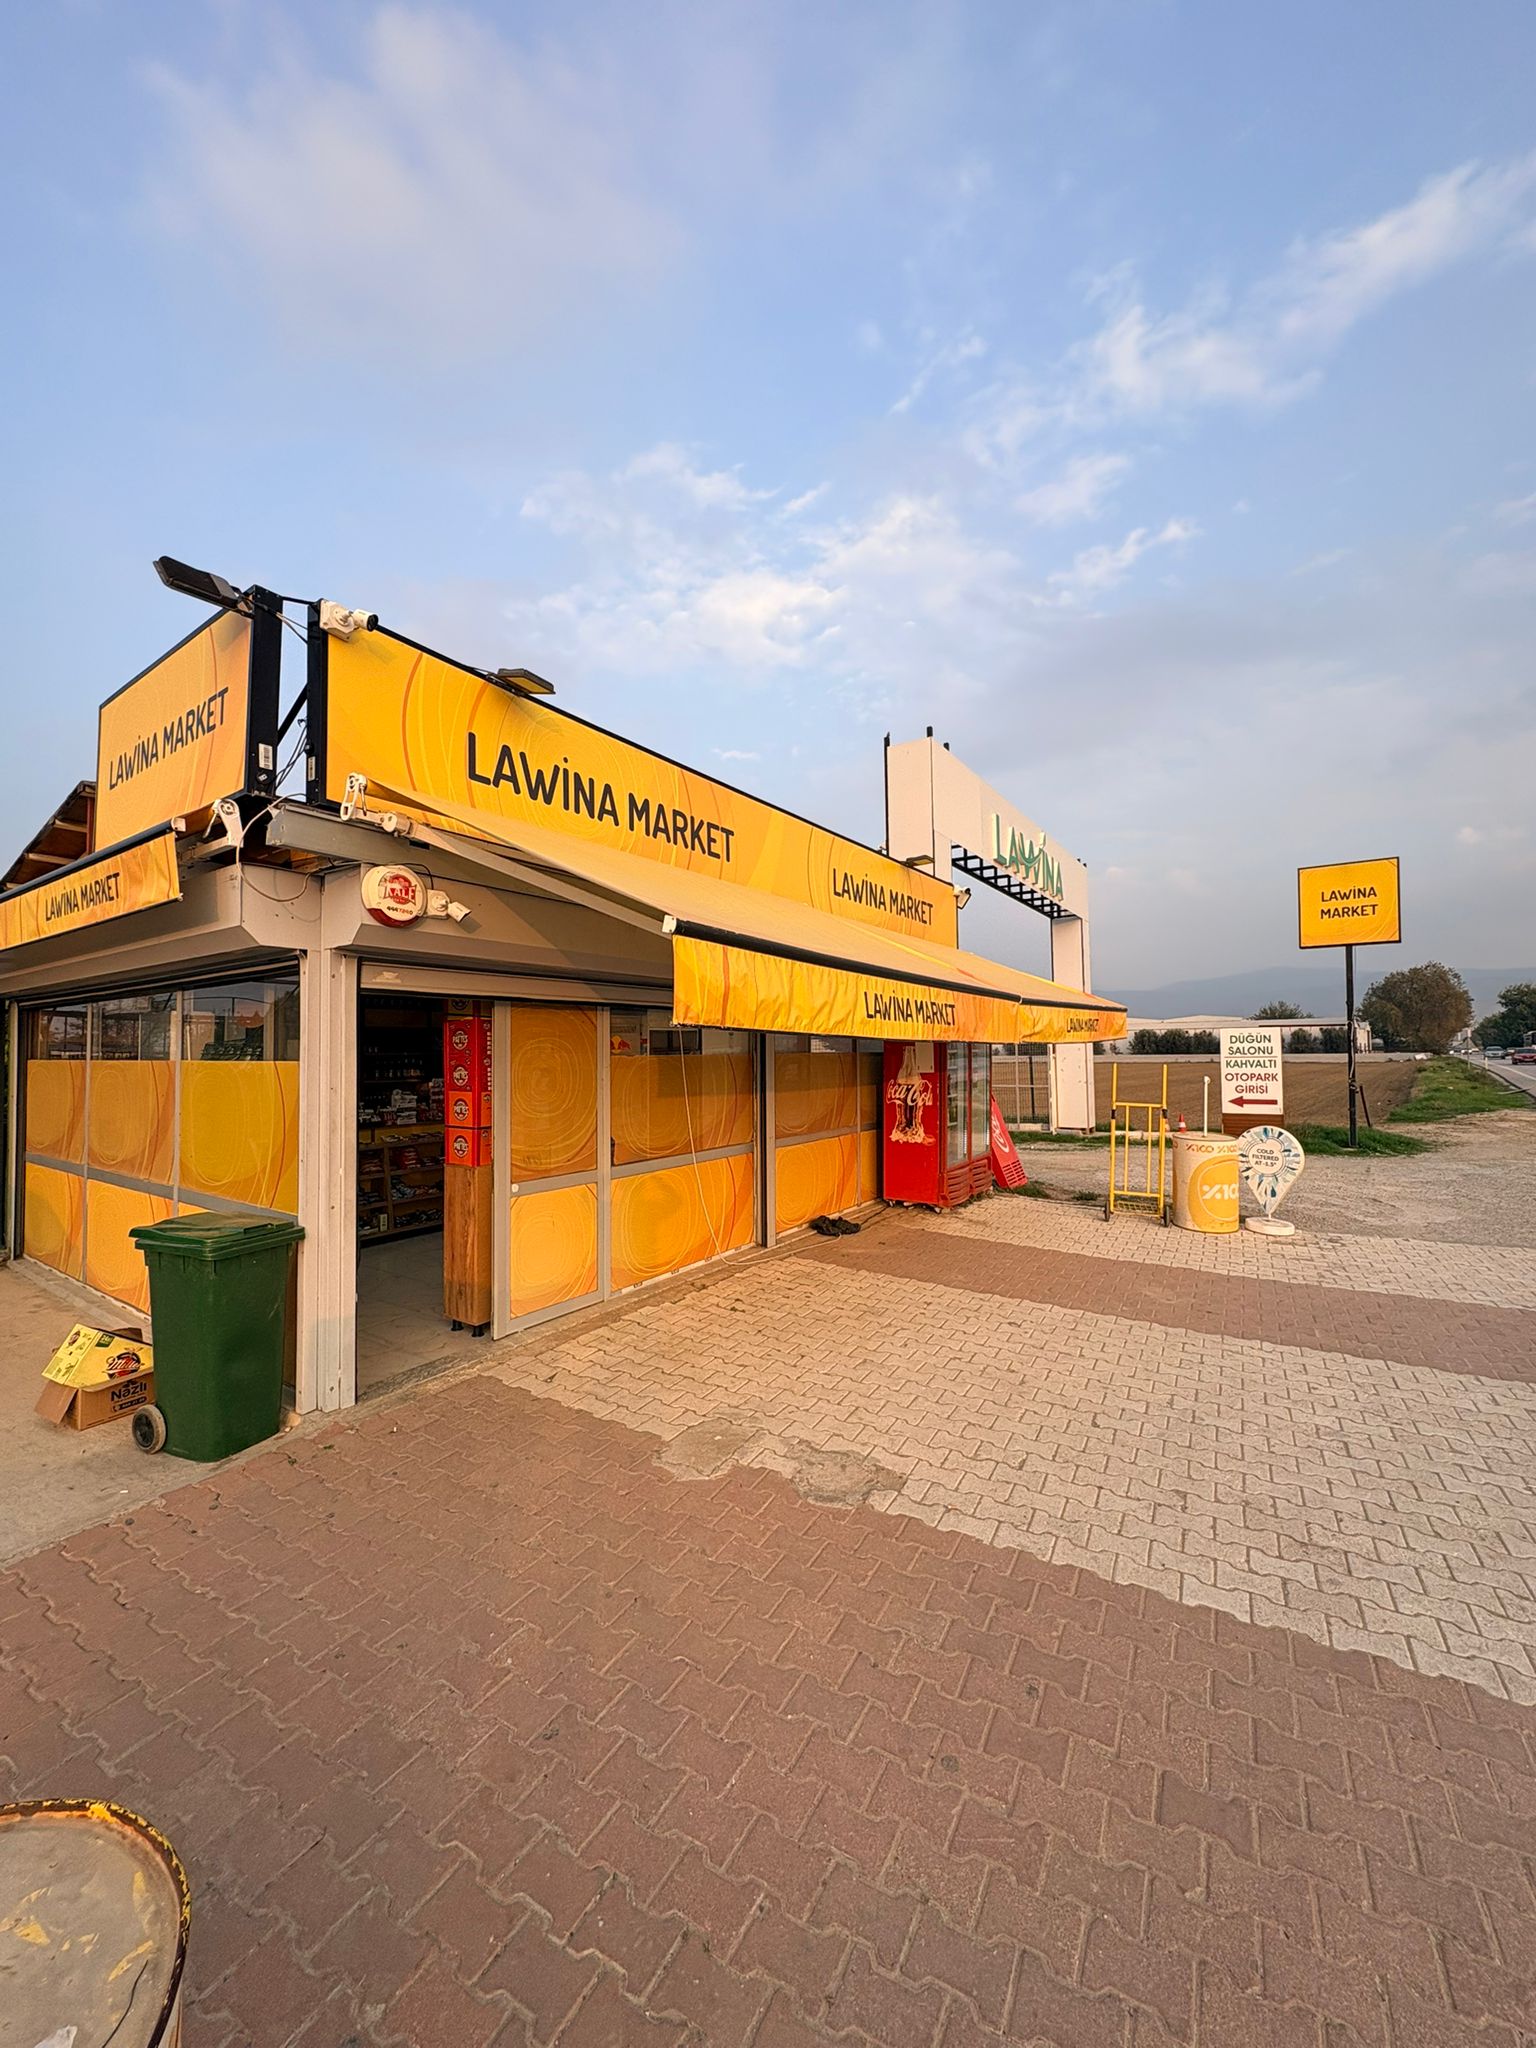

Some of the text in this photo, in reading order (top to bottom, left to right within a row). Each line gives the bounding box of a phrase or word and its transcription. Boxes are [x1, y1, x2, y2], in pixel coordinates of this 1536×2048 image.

[162, 686, 229, 759] MARKET
[628, 792, 735, 863] MARKET
[80, 872, 120, 911] MARKET
[889, 889, 934, 926] MARKET
[1320, 904, 1379, 920] MARKET
[914, 999, 956, 1026] MARKET
[1229, 1032, 1271, 1044] DÜĞÜN
[1228, 1046, 1273, 1055] SALONU
[1225, 1059, 1277, 1068] KAHVALTI
[1224, 1072, 1278, 1082] OTOPARK
